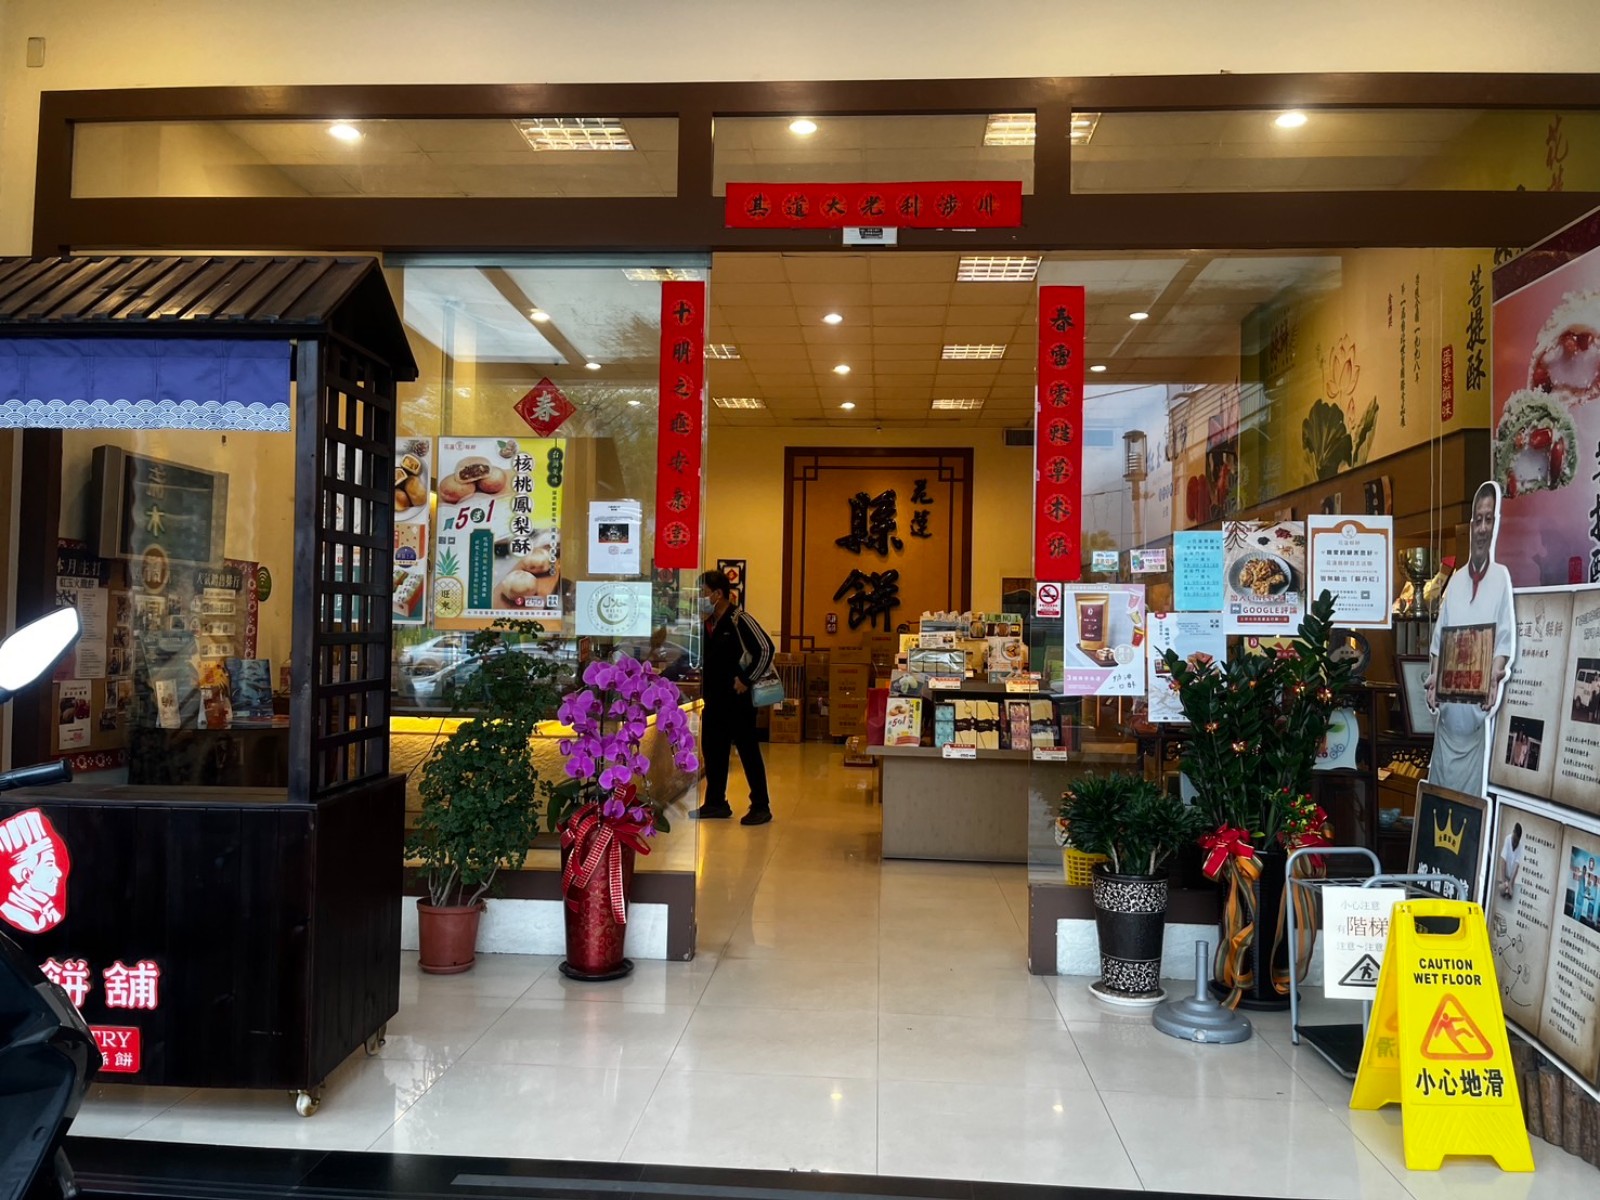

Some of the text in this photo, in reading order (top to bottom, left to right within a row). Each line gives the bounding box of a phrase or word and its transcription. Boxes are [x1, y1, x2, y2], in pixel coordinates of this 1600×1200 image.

[748, 191, 996, 219] 其道大光利涉川
[530, 390, 560, 422] 春
[512, 454, 533, 555] 核桃鳳梨酥
[1419, 958, 1473, 971] CAUTION
[1413, 973, 1482, 986] WET FLOOR
[1416, 1069, 1504, 1097] 小心地滑
